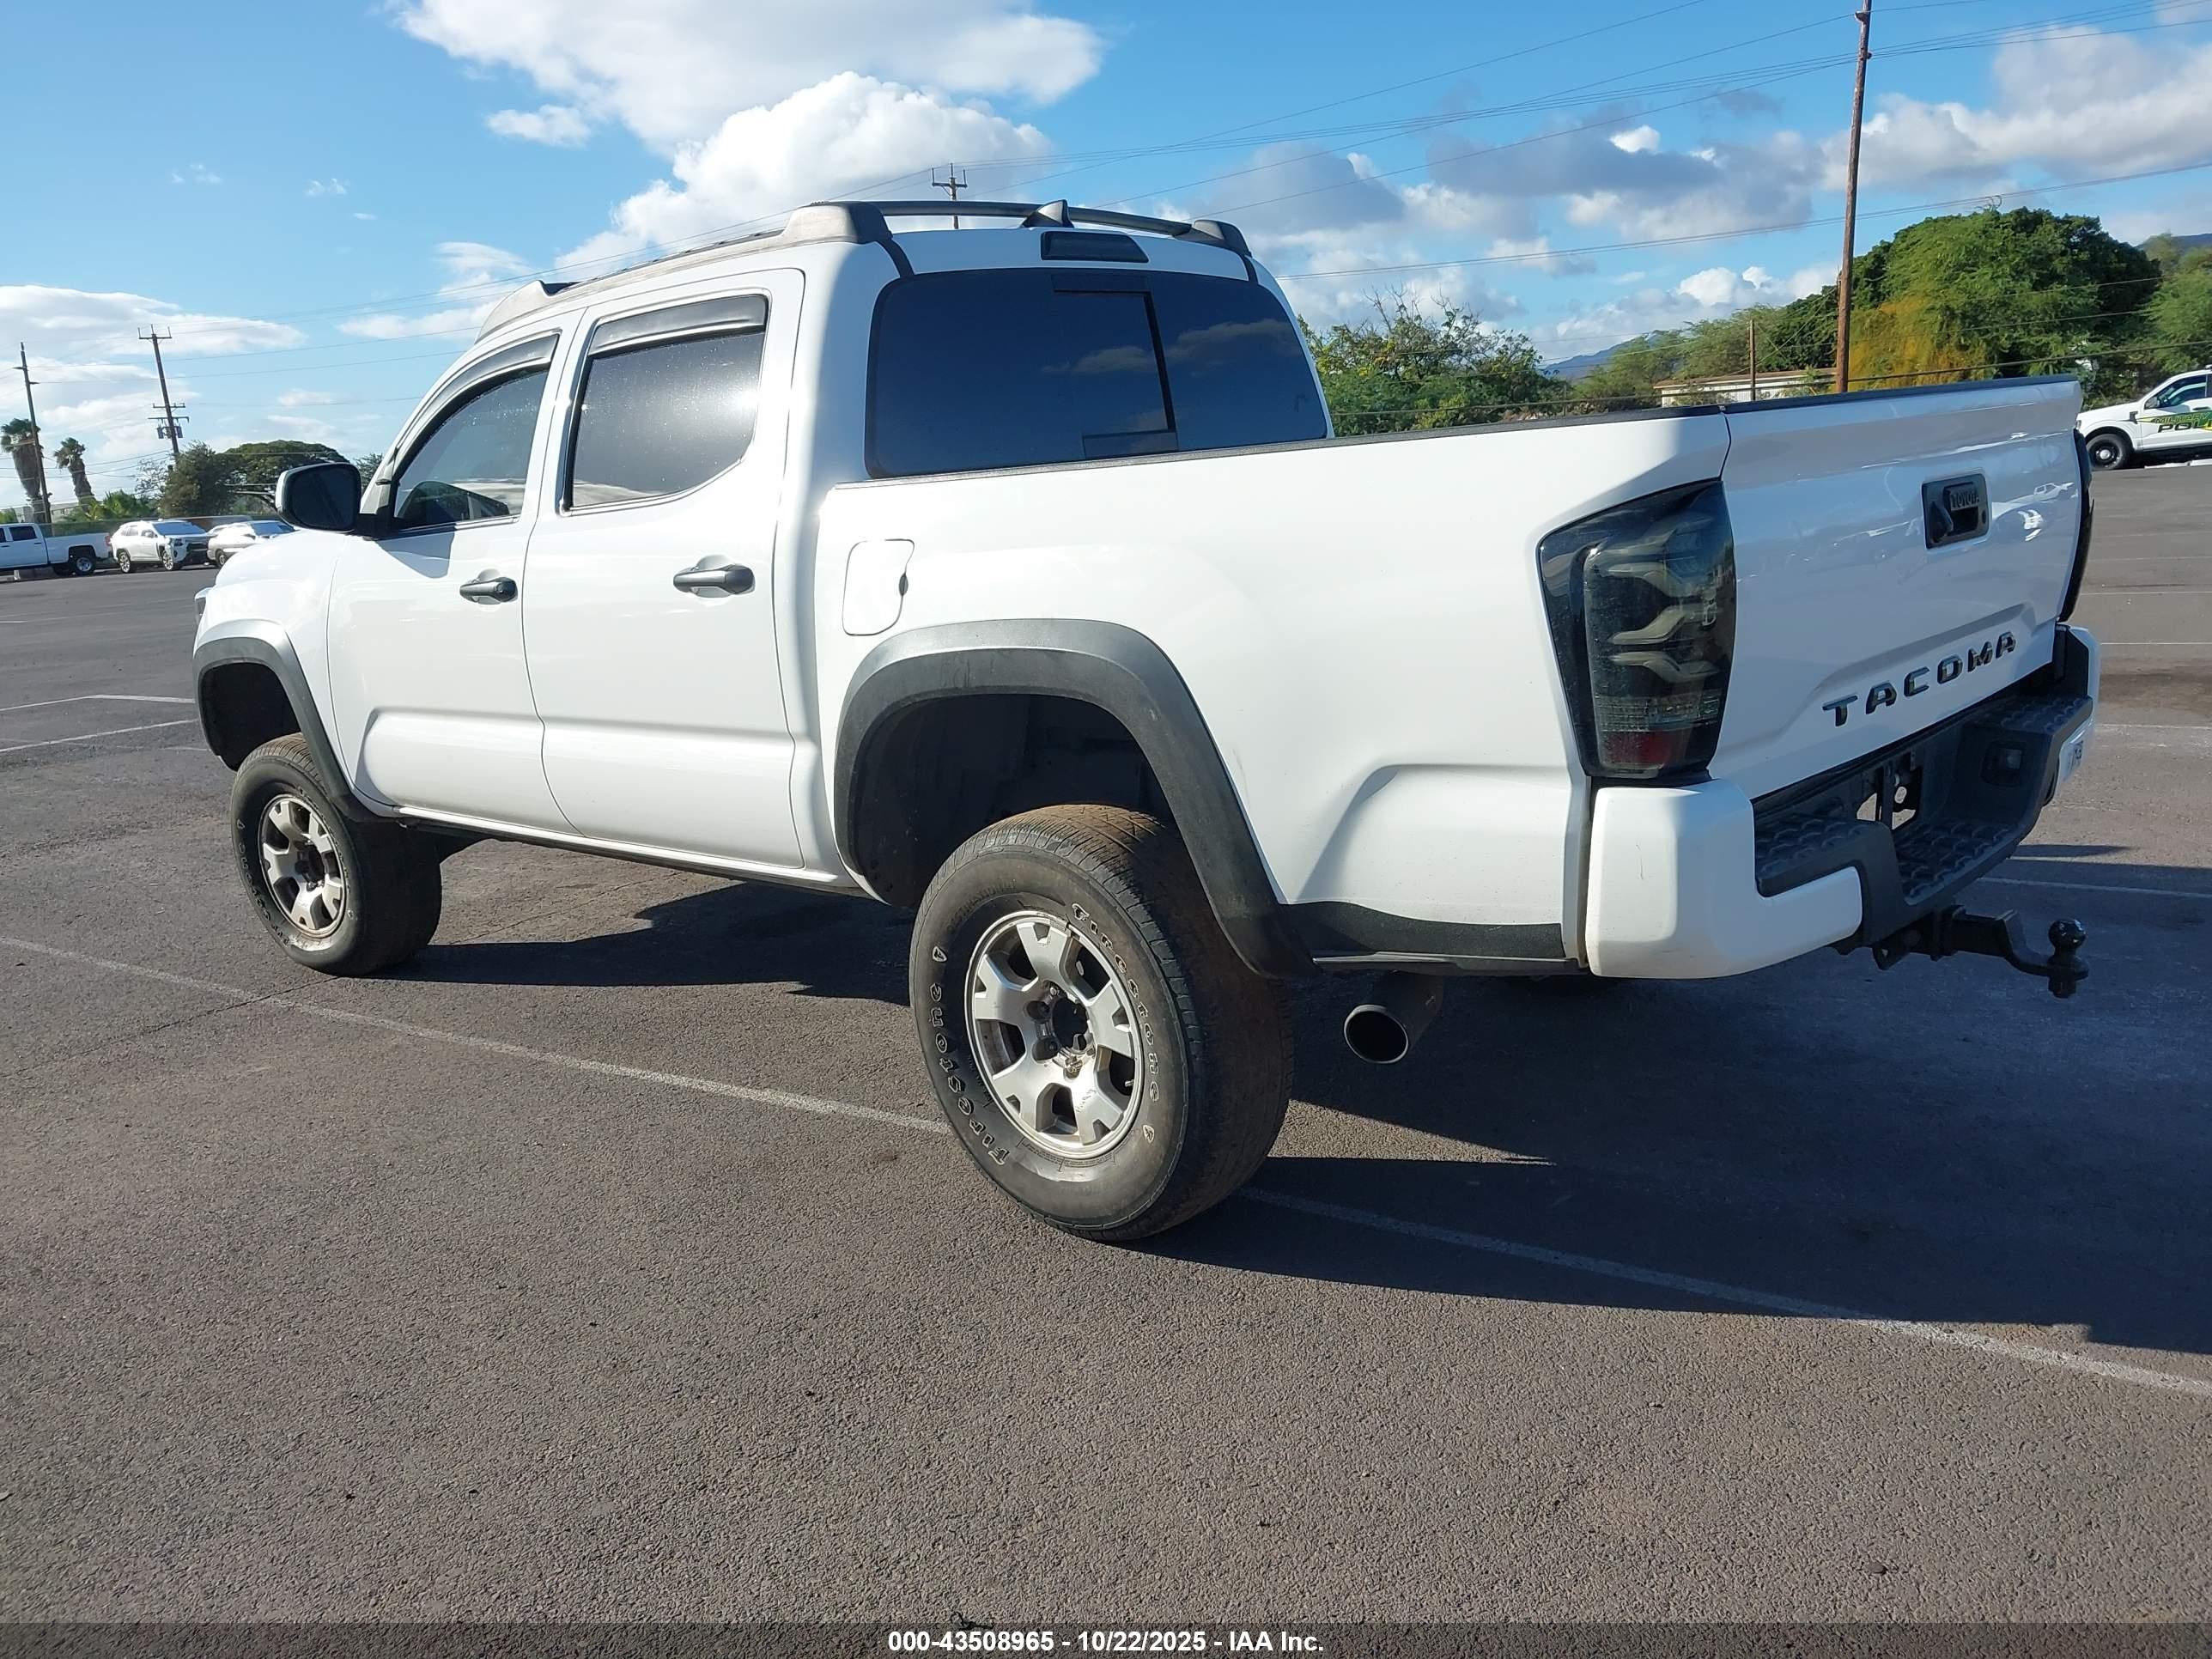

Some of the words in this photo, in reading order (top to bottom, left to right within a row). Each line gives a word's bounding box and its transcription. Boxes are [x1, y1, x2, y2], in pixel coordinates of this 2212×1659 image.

[1822, 631, 2016, 726] TACOMA
[930, 982, 1010, 1165] Firestone
[1073, 903, 1159, 1102] Firestone
